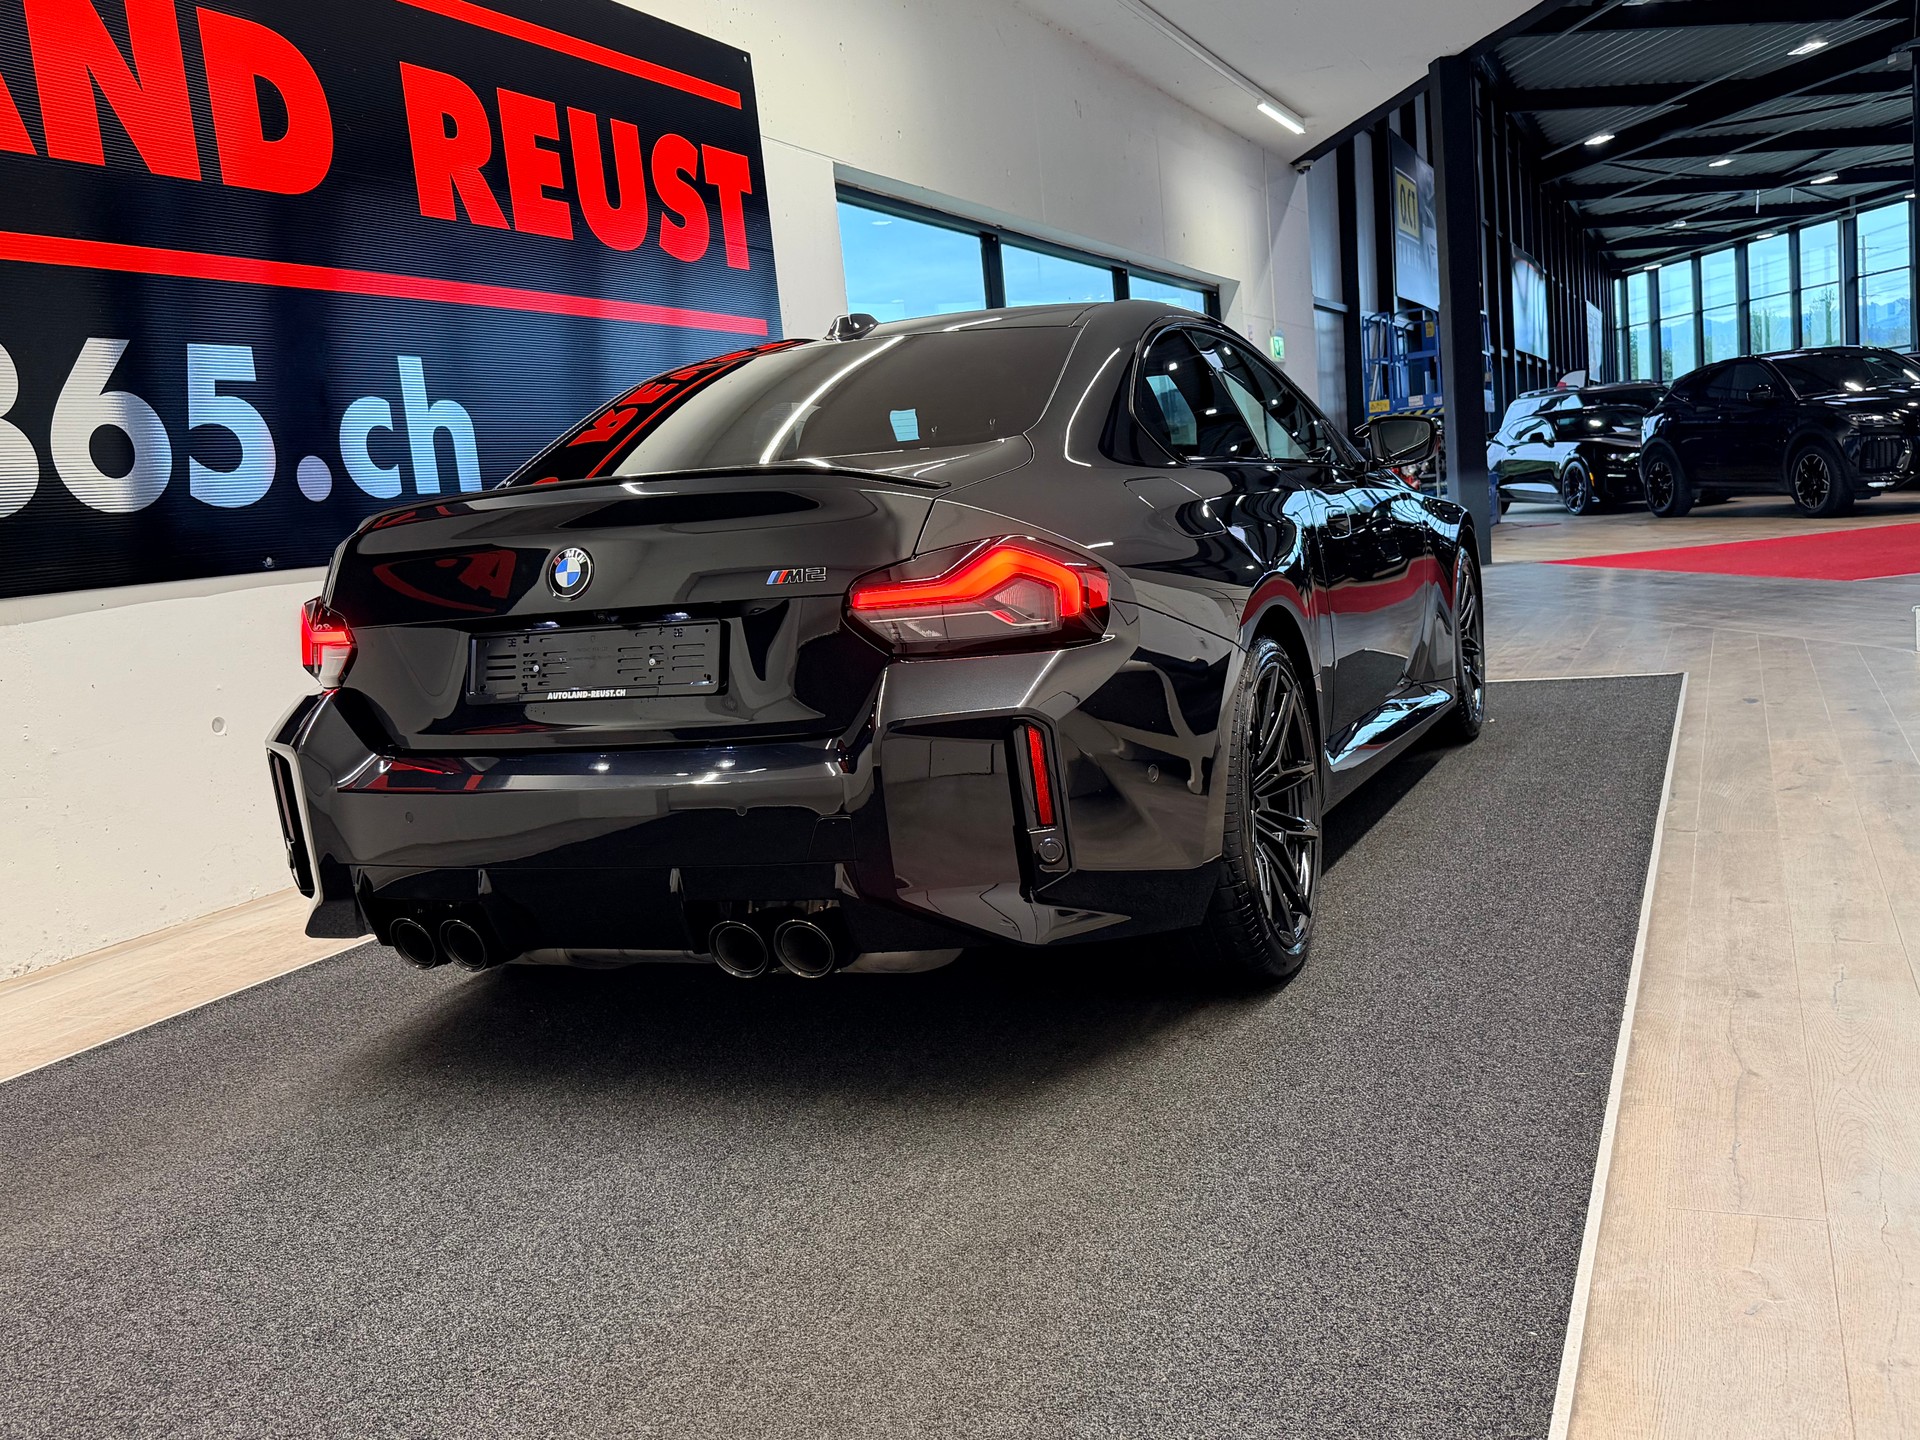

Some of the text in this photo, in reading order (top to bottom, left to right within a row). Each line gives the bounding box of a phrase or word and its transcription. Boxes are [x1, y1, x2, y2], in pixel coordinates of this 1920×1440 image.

[0, 0, 752, 270] ND REUST
[779, 566, 827, 584] M2
[547, 688, 627, 700] AUTOLAND-REUST.CH
